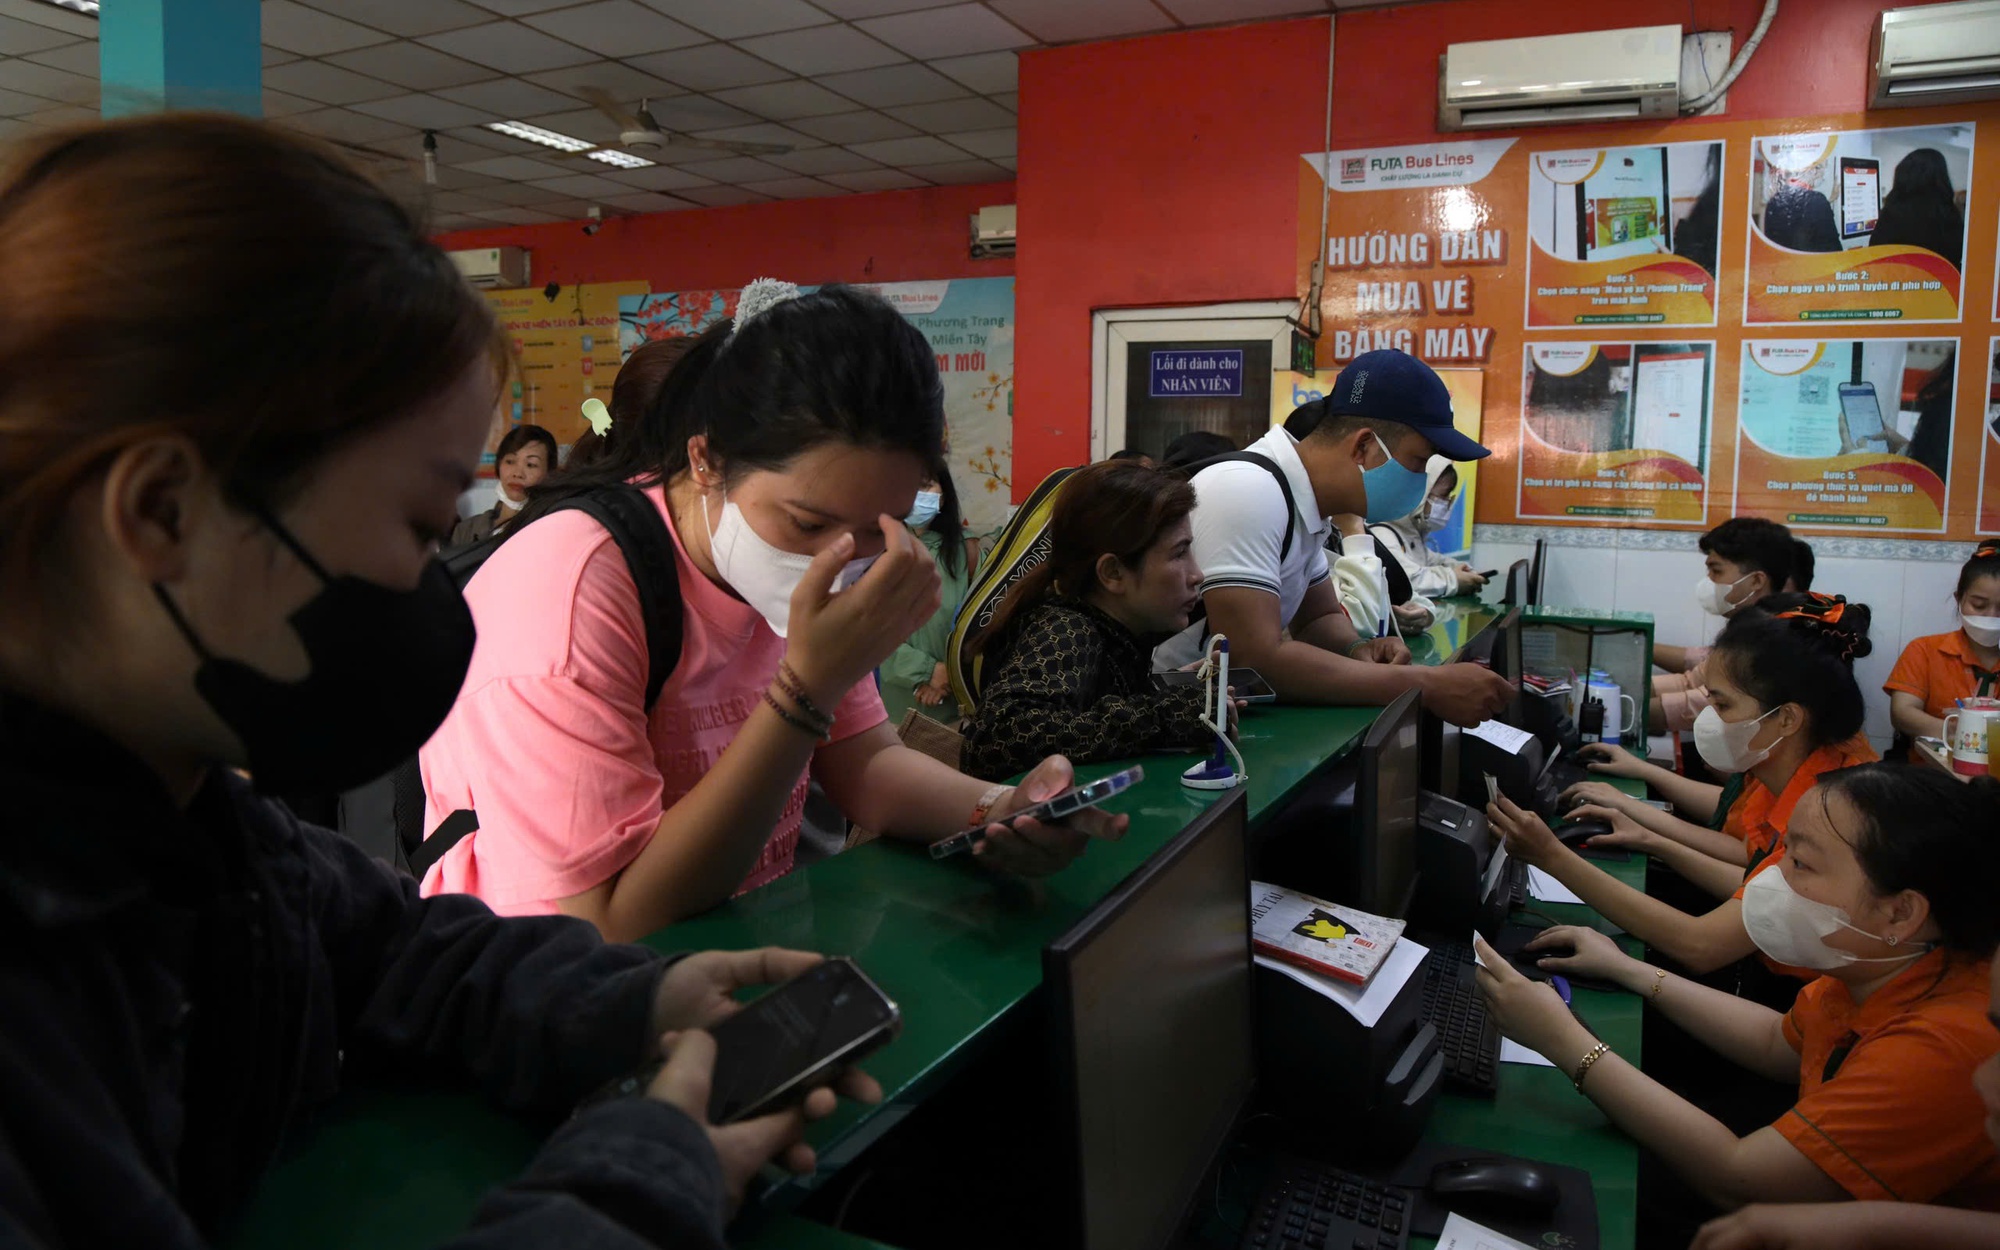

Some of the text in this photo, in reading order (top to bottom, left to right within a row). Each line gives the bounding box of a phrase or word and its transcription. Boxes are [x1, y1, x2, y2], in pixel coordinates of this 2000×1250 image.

[1371, 153, 1474, 171] FUTA Bus Lines
[1328, 230, 1429, 266] HƯỚNG
[1835, 270, 1869, 280] Bước 2:
[1356, 275, 1468, 312] MUA VÉ
[1766, 285, 1789, 295] Chọn
[1814, 284, 1825, 293] và
[1890, 280, 1900, 290] đi
[1923, 279, 1941, 291] hợp
[918, 316, 968, 329] Phương
[971, 315, 1005, 329] Trang
[932, 333, 988, 346] Miền Tây
[1424, 323, 1490, 358] MÁY
[955, 350, 986, 372] MỚI
[1156, 354, 1238, 370] Lối đi dành cho
[1161, 375, 1231, 391] NHÂN VIÊN
[1767, 480, 1789, 491] Chọn
[1791, 481, 1824, 492] phương
[1901, 484, 1914, 493] QR
[1819, 493, 1845, 503] thanh
